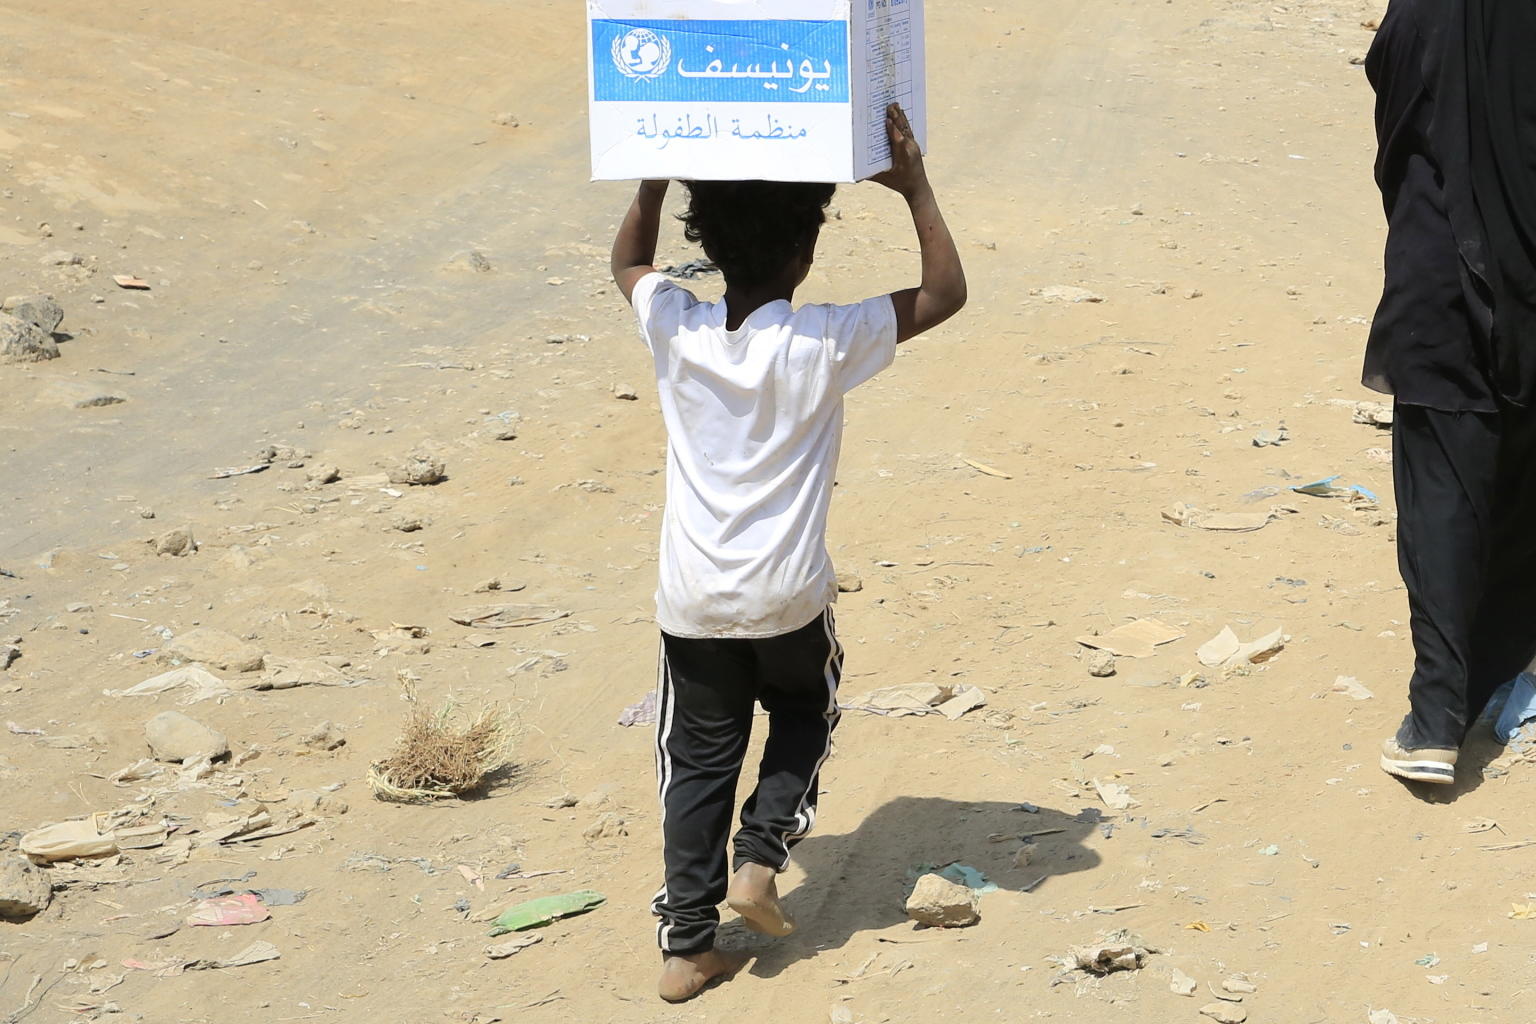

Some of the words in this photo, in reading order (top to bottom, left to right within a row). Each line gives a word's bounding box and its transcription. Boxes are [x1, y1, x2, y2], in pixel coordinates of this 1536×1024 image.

[677, 42, 831, 94] يونيسف
[636, 112, 718, 150] الطفولة
[731, 112, 807, 140] منظمة
